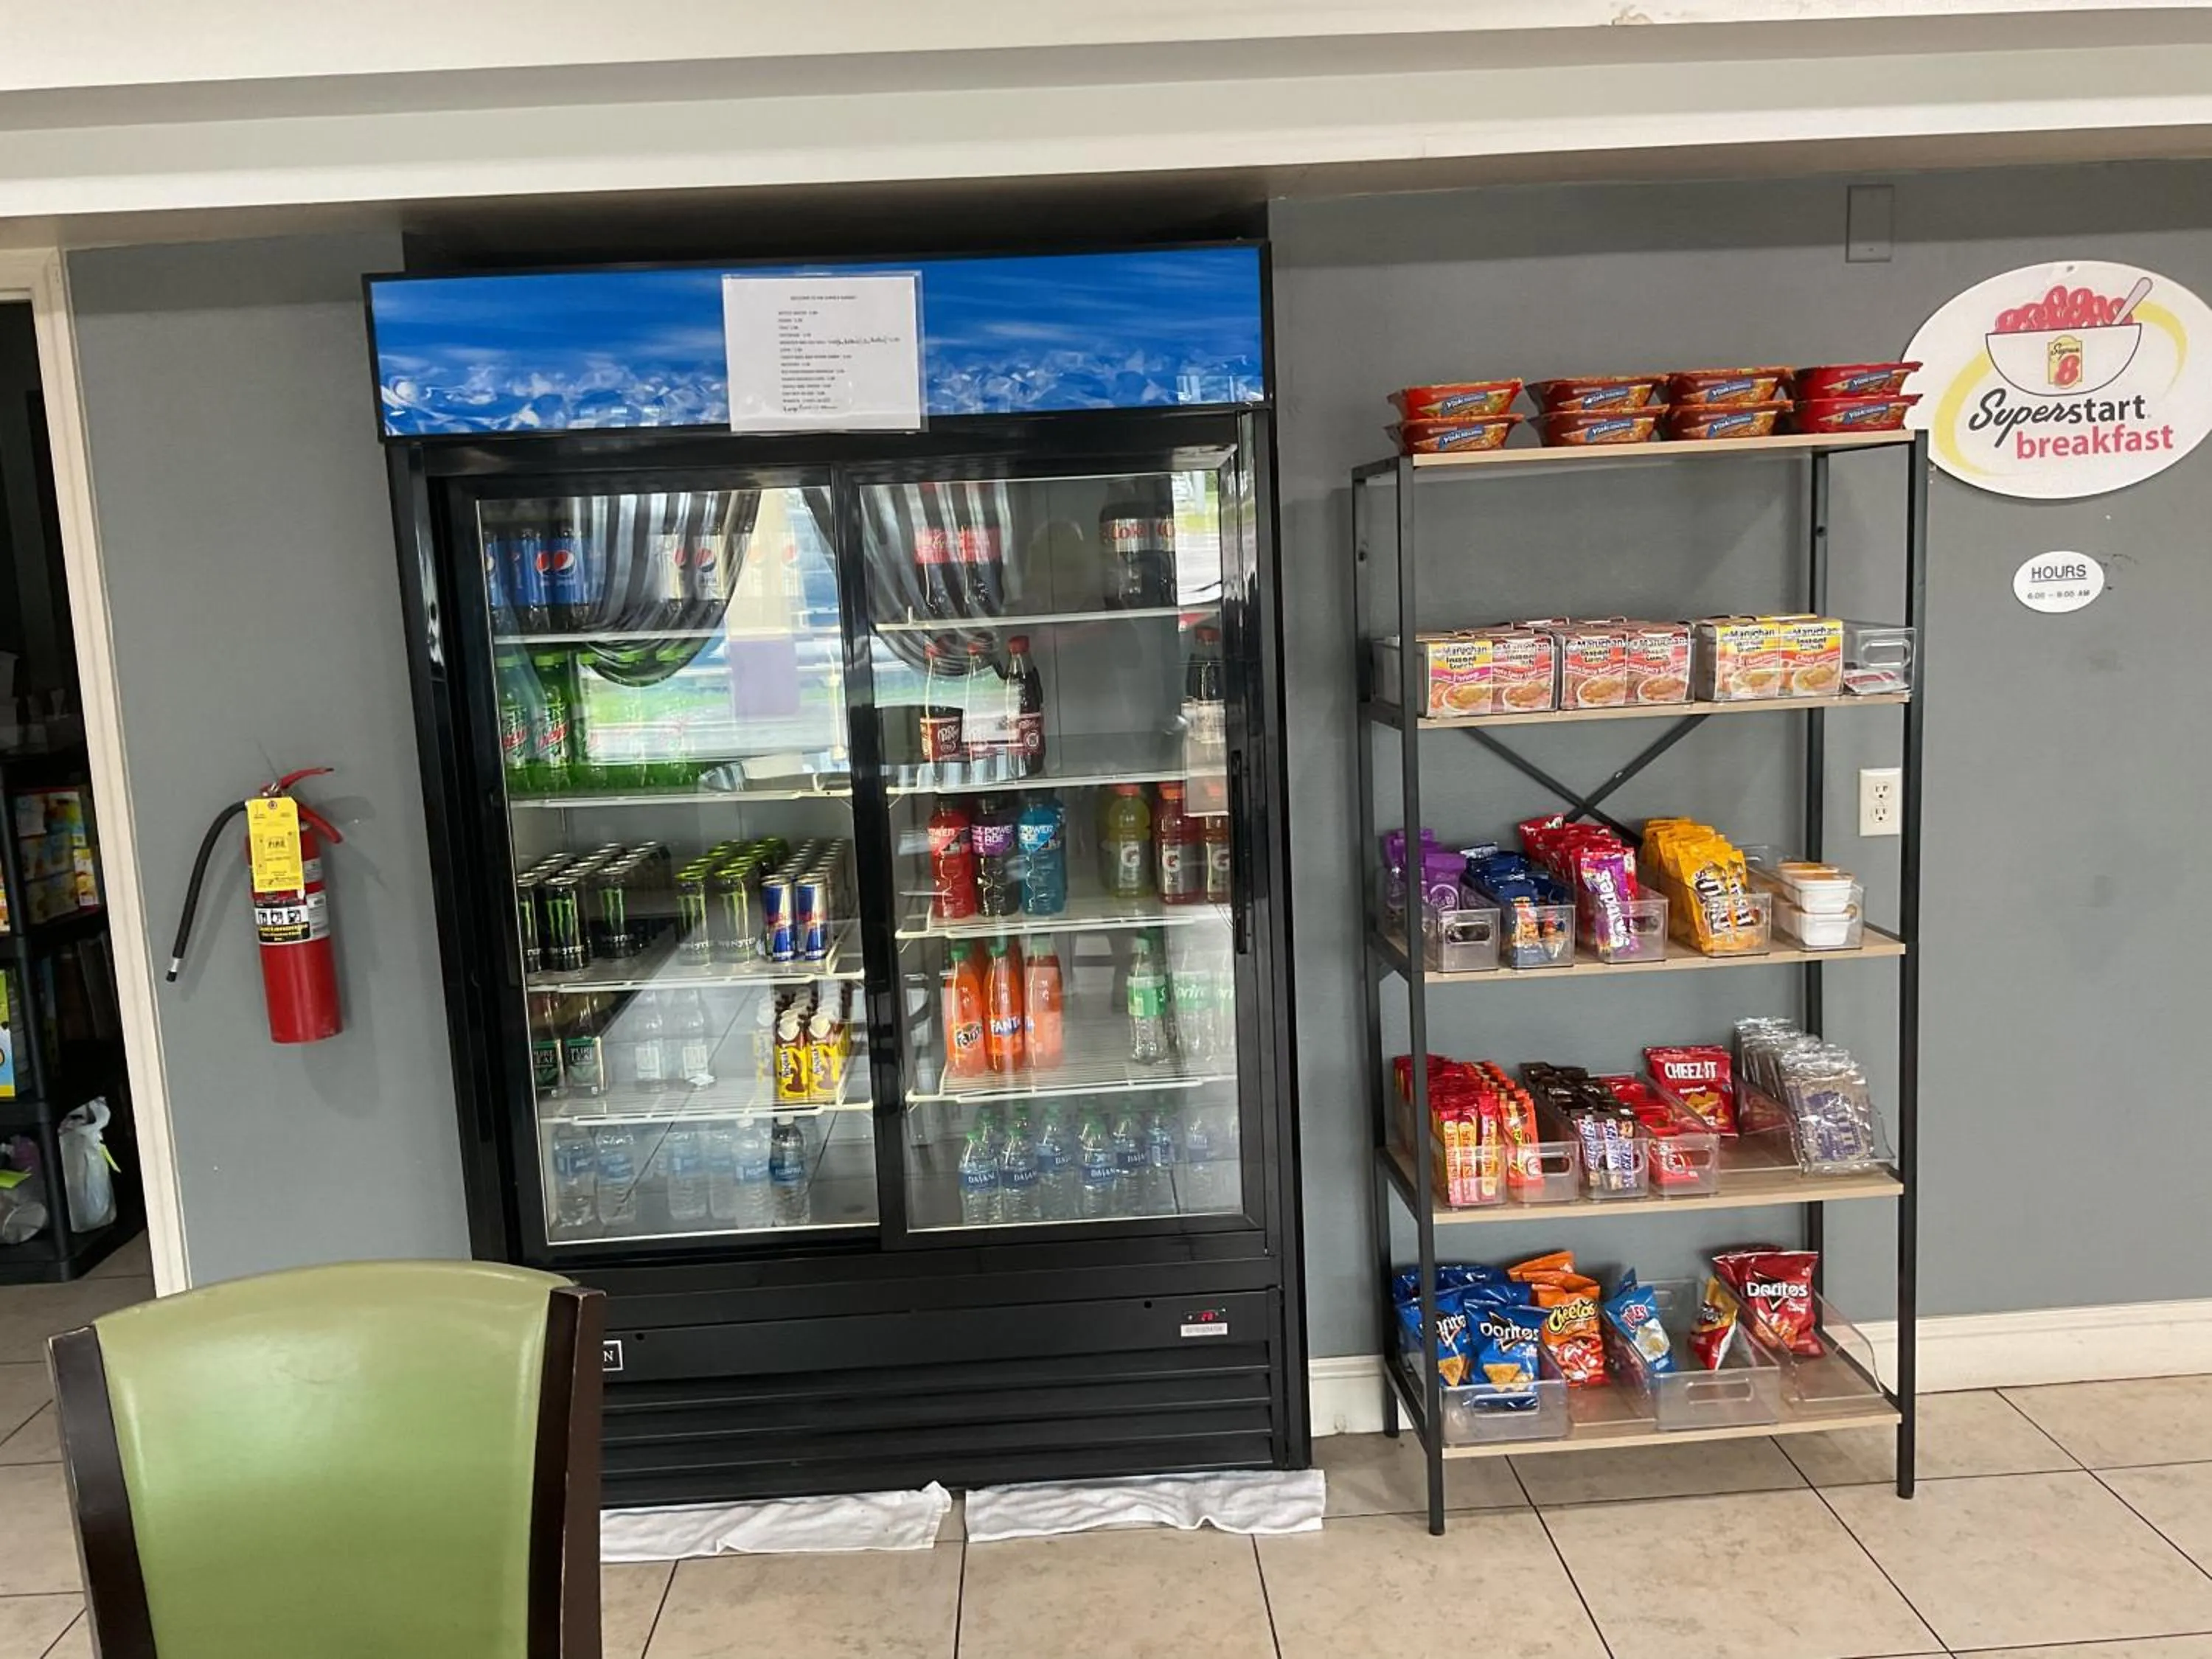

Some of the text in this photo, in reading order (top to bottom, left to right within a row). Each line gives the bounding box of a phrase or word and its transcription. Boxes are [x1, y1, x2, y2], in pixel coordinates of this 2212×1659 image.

[2055, 354, 2080, 386] 8
[1969, 389, 2145, 448] Superstart
[2016, 424, 2173, 459] breakfast
[2031, 564, 2086, 579] HOURS
[990, 1015, 1022, 1034] FANT
[1664, 1061, 1717, 1079] CHEEZ-IT
[968, 1172, 995, 1183] DASAN
[1747, 1281, 1808, 1297] Doritos
[1549, 1299, 1596, 1332] Cheetos
[1479, 1319, 1539, 1342] Doritos
